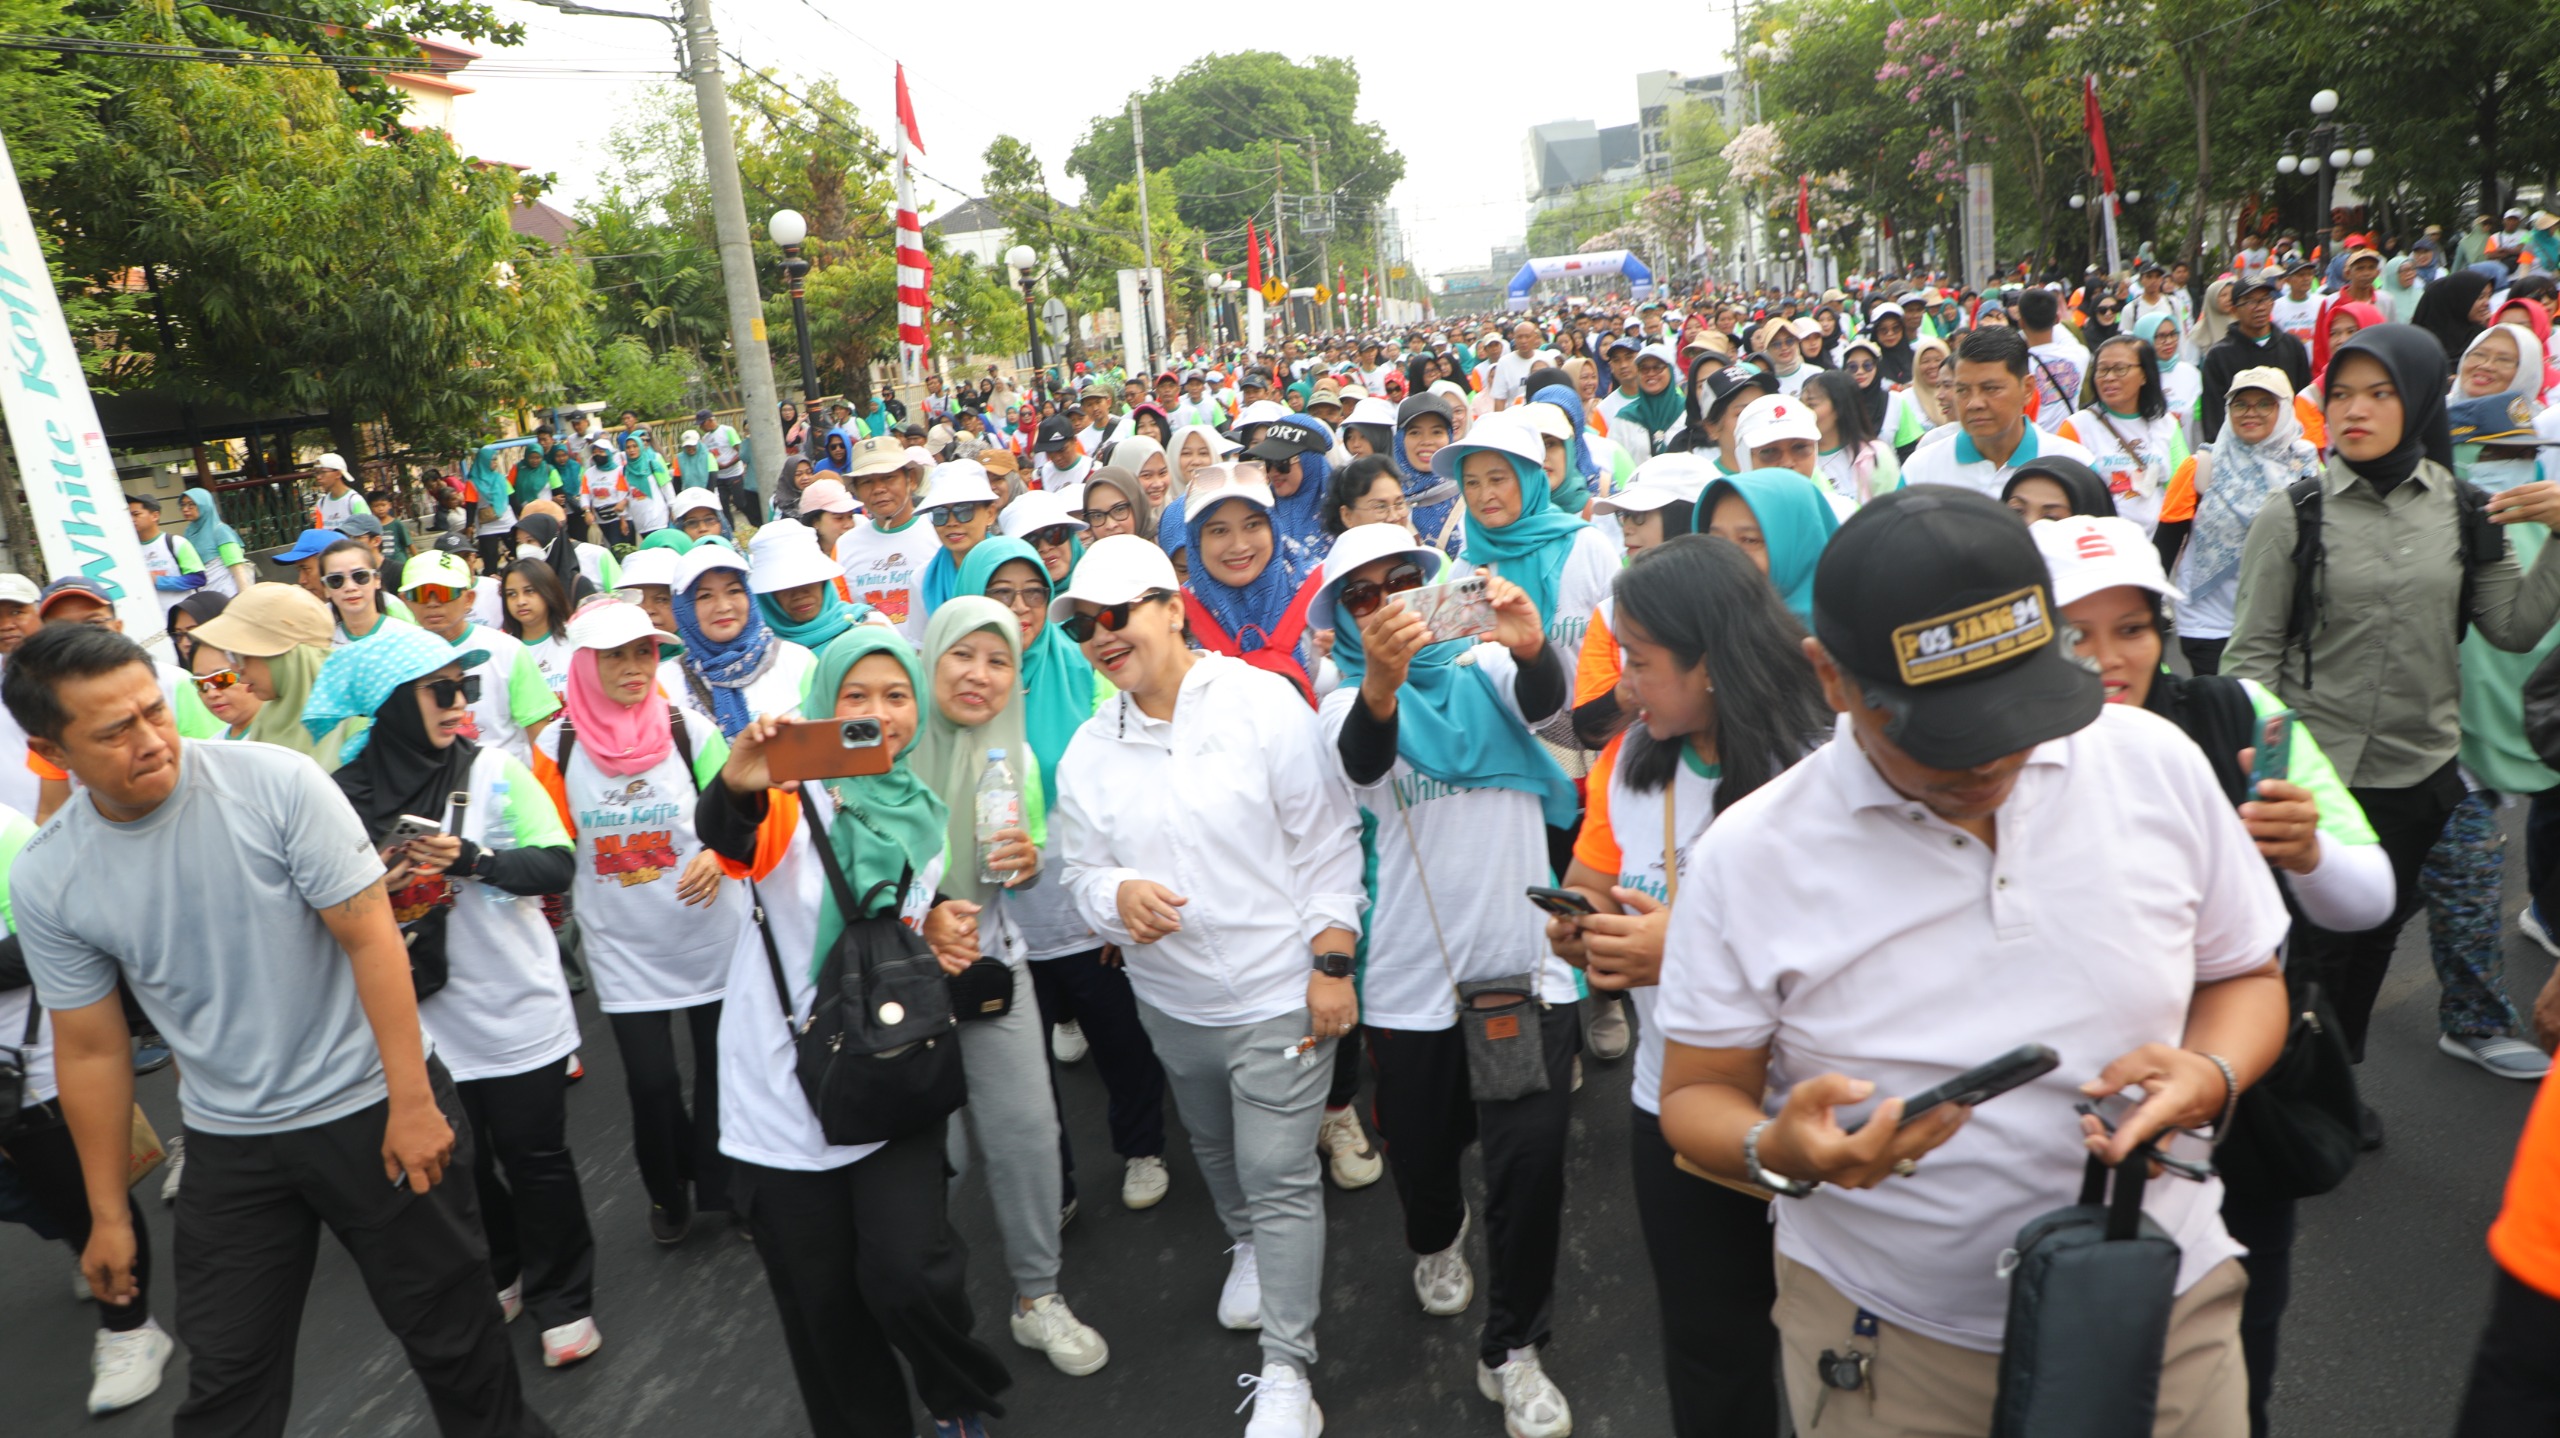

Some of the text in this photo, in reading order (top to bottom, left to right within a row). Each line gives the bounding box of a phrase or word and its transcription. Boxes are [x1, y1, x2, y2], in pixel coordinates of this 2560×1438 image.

[45, 418, 127, 601] White
[888, 569, 914, 585] Koff
[1545, 615, 1592, 649] offi
[580, 803, 681, 829] White Koffie
